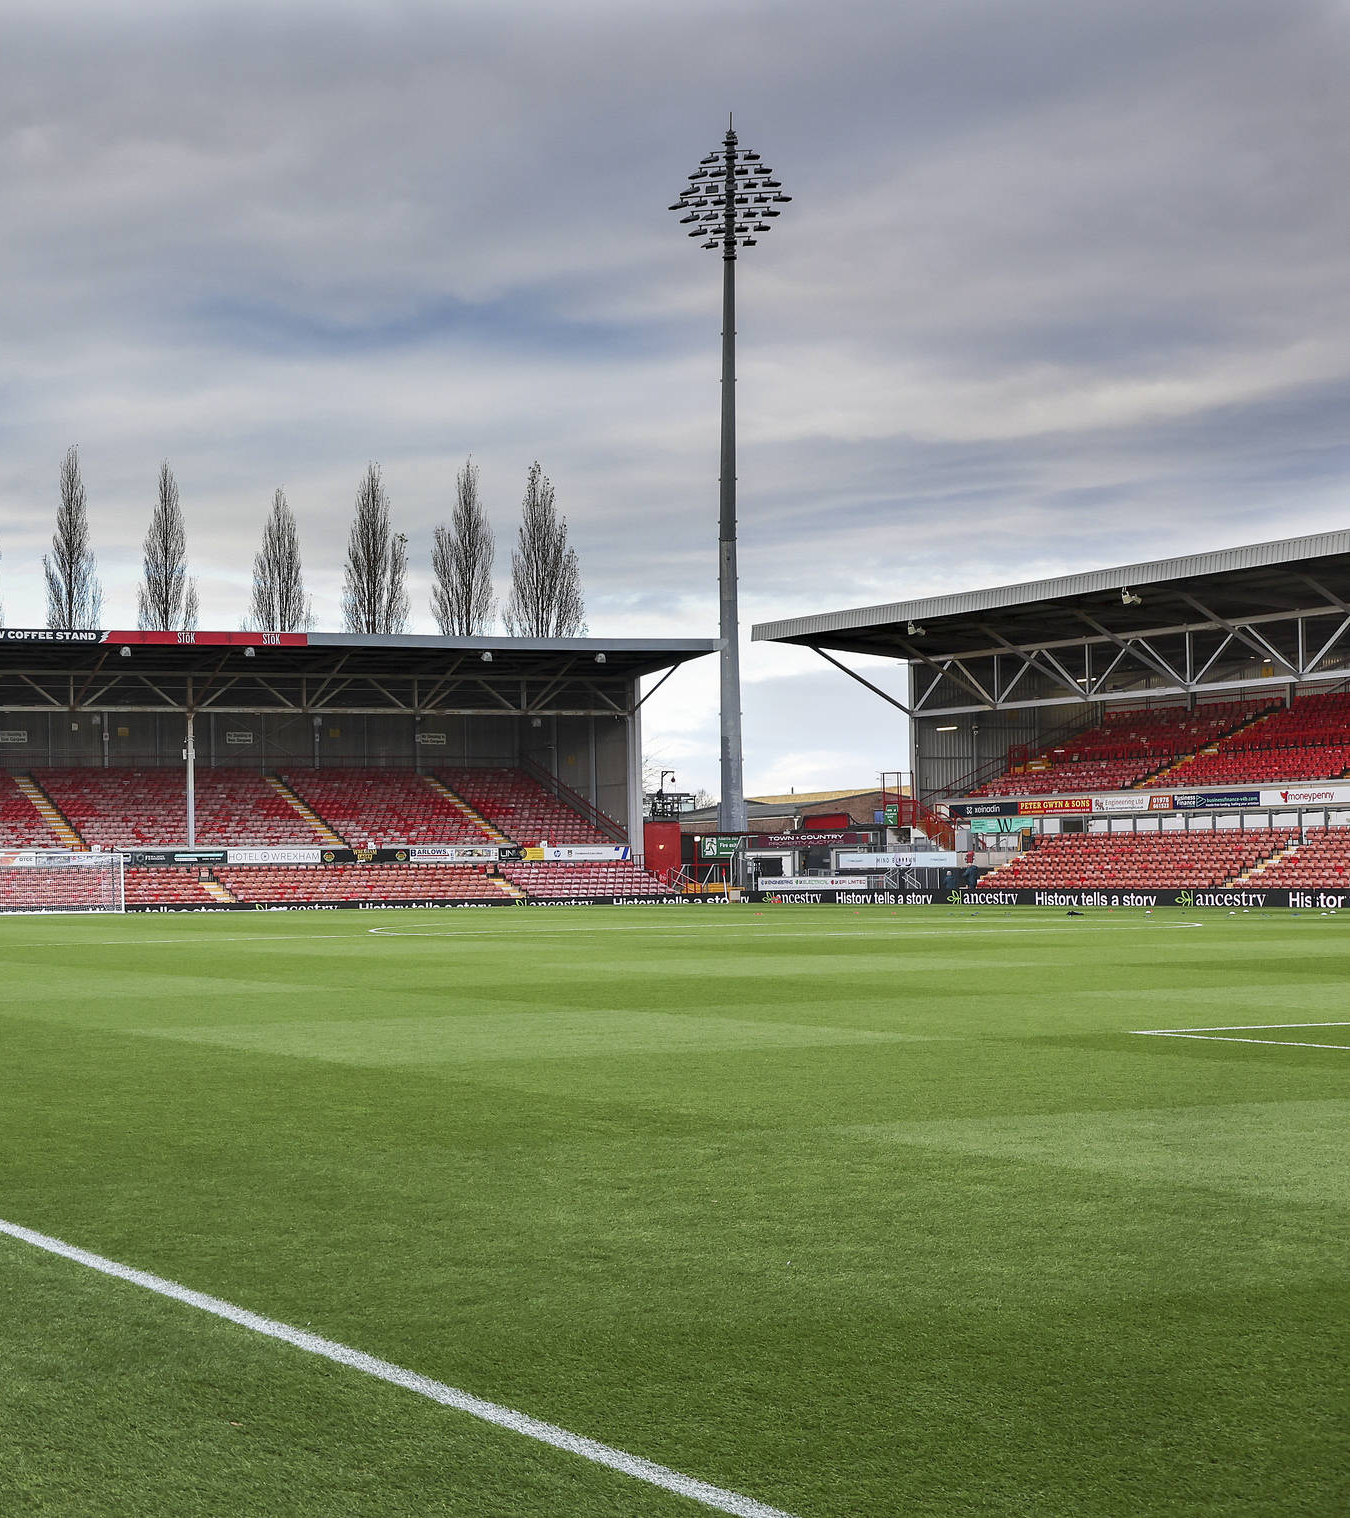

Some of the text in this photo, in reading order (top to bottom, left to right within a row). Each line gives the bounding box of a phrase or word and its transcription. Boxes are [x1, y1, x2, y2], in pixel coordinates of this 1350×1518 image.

[7, 631, 54, 640] COFFEE
[56, 631, 97, 640] STAND
[1287, 791, 1335, 801] moneypenny
[1020, 802, 1042, 810] PETER
[1071, 799, 1090, 807] SONS
[1105, 799, 1135, 807] Engineering
[1136, 797, 1144, 805] Ltd
[228, 852, 259, 861] HOTEL
[271, 851, 320, 860] WREXHAM
[410, 849, 447, 857] BARLOWS
[835, 891, 932, 904] History tells a story
[963, 891, 1018, 905] ancestry
[1035, 892, 1157, 907] History tells a story
[1195, 891, 1267, 907] ancestry
